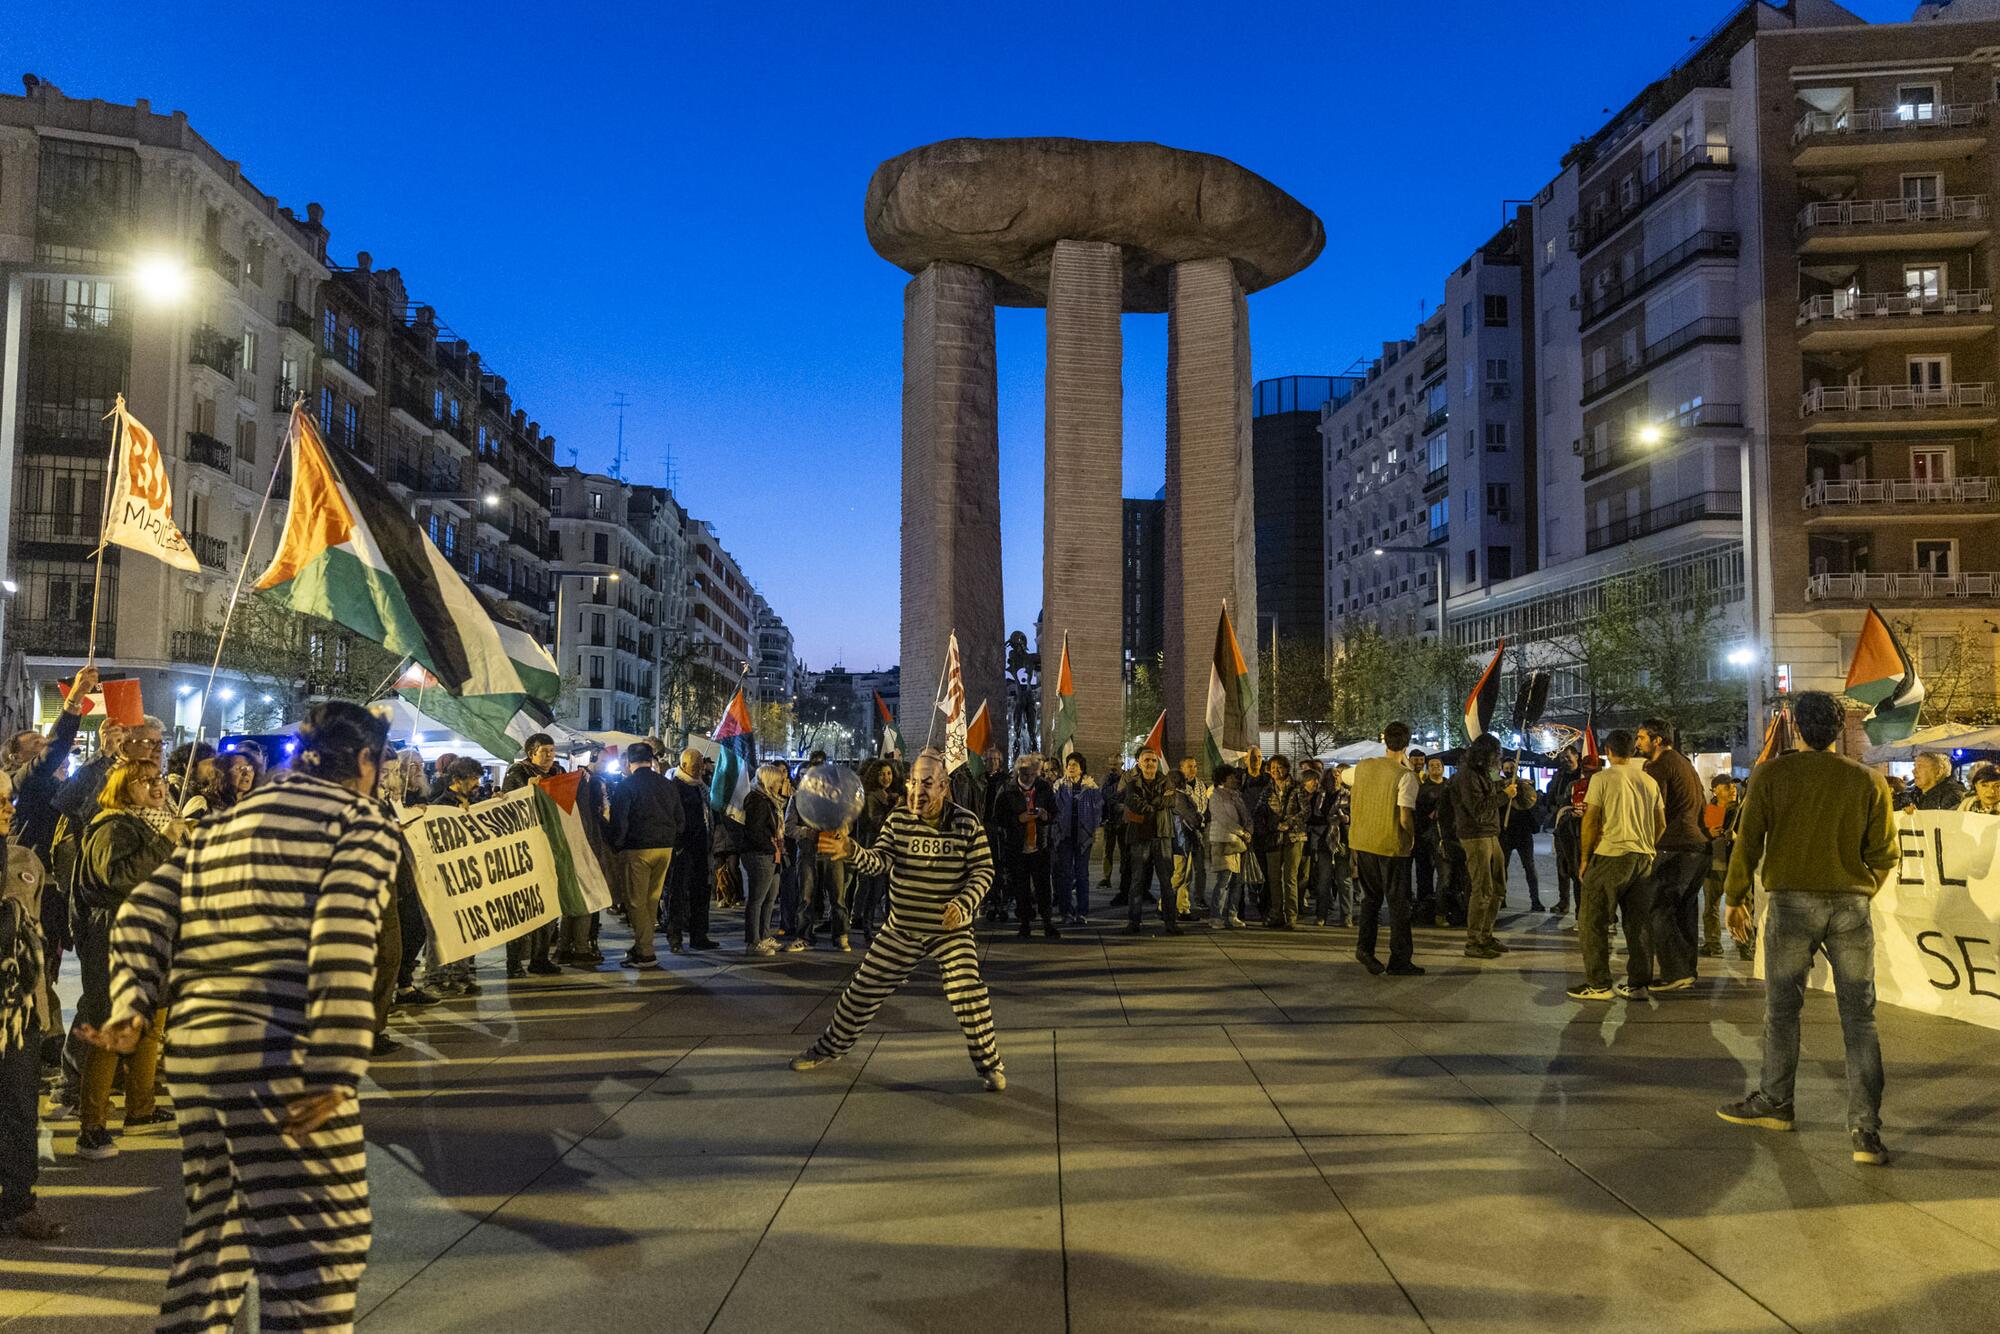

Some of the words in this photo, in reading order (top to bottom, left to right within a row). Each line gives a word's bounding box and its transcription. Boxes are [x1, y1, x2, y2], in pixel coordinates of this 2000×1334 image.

[424, 816, 468, 854] ERA
[458, 813, 491, 844] EL
[476, 796, 538, 838] SIONISM
[911, 838, 951, 854] 8686
[448, 855, 483, 895] LAS
[484, 840, 534, 885] CALLES
[1897, 827, 1967, 887] EL
[461, 905, 490, 941] LAS
[485, 883, 545, 933] CANCHAS
[1916, 930, 2000, 1000] SE
